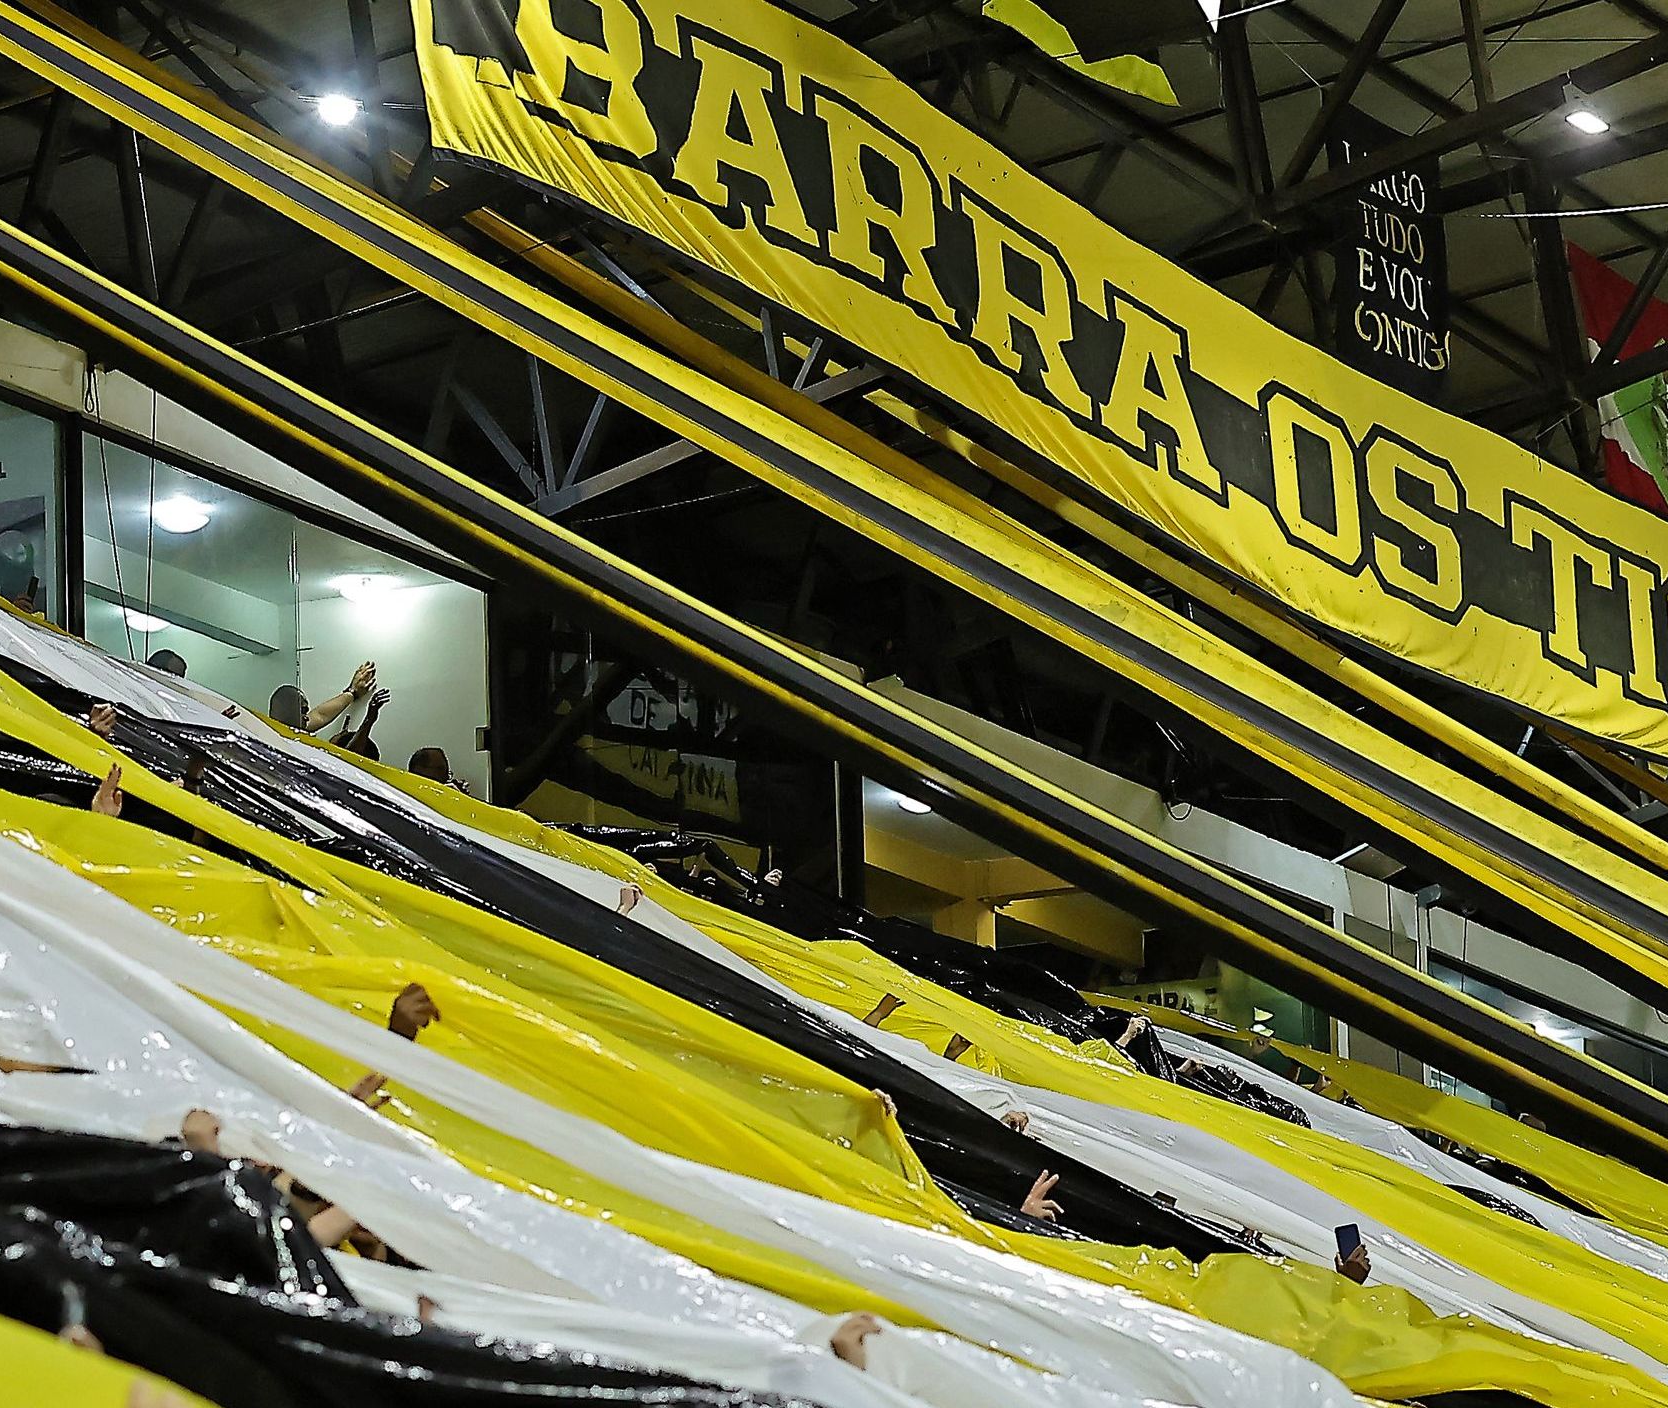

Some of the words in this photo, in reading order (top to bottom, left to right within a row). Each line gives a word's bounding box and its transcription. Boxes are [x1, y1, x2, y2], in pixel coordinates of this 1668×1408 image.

[1358, 199, 1424, 264] TUDO
[1356, 246, 1377, 292] E
[514, 0, 1228, 507] BARRA
[1258, 382, 1466, 626] OS
